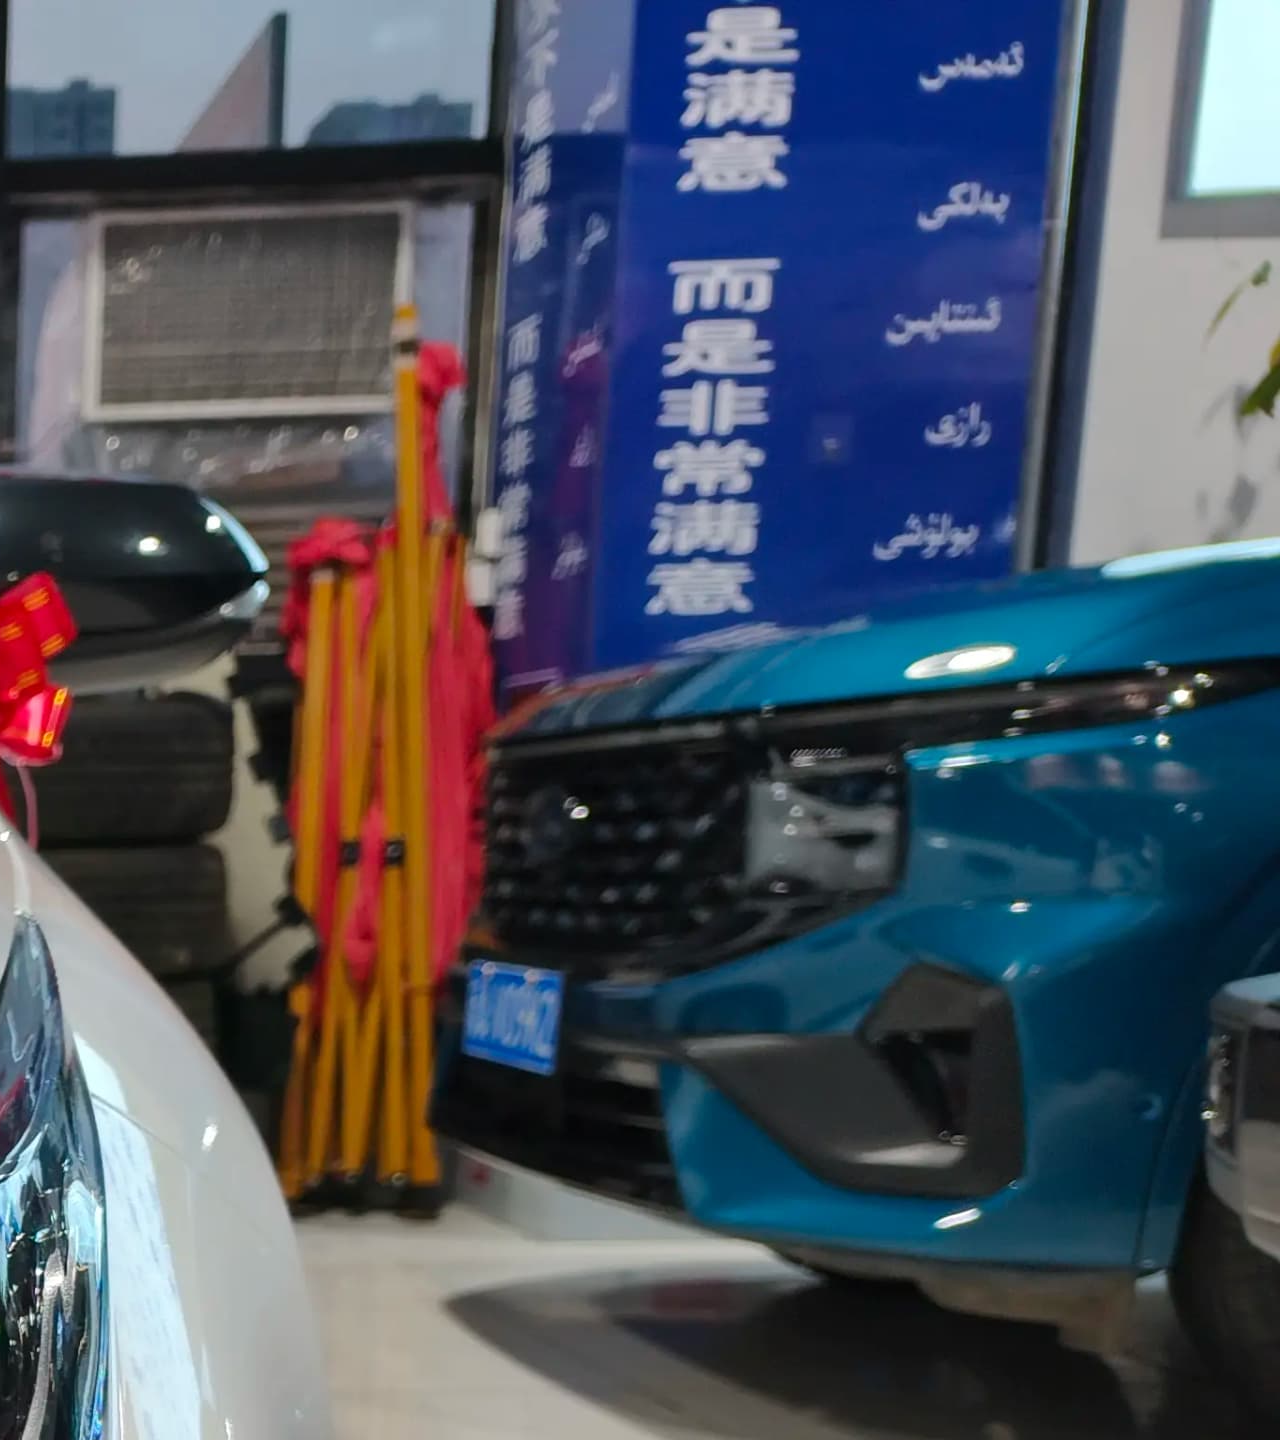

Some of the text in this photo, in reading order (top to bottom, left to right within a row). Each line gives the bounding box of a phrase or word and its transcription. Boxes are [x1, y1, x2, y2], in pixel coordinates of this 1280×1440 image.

[643, 5, 801, 616] 是满意 而是非常满意
